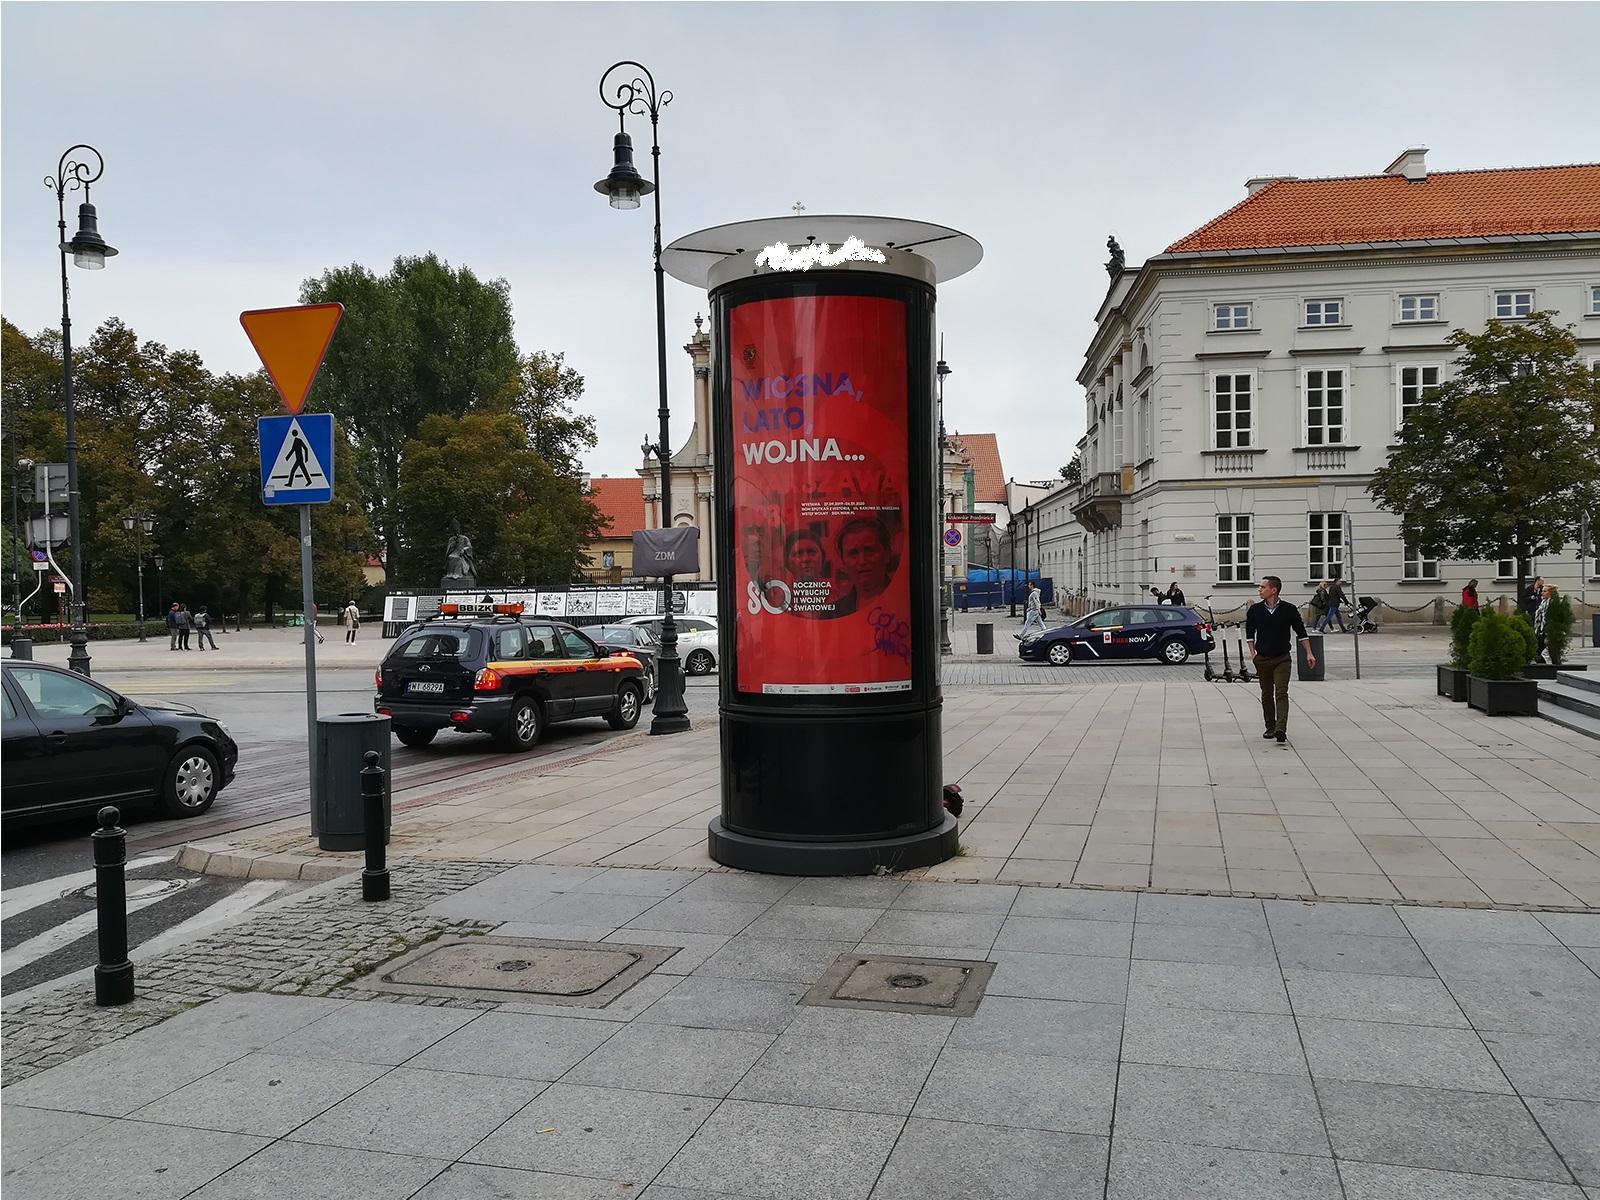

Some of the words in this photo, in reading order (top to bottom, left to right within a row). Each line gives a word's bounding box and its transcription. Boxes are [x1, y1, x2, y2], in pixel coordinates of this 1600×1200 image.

[742, 372, 863, 401] WIOSNA,
[742, 406, 813, 435] LATO,
[742, 437, 865, 466] WOJNA...
[655, 551, 675, 561] ZDM
[793, 581, 832, 589] ROCZNICA
[459, 604, 492, 612] BBiZK
[793, 604, 836, 612] ŚWIATOWEJ
[423, 683, 443, 691] 6829A
